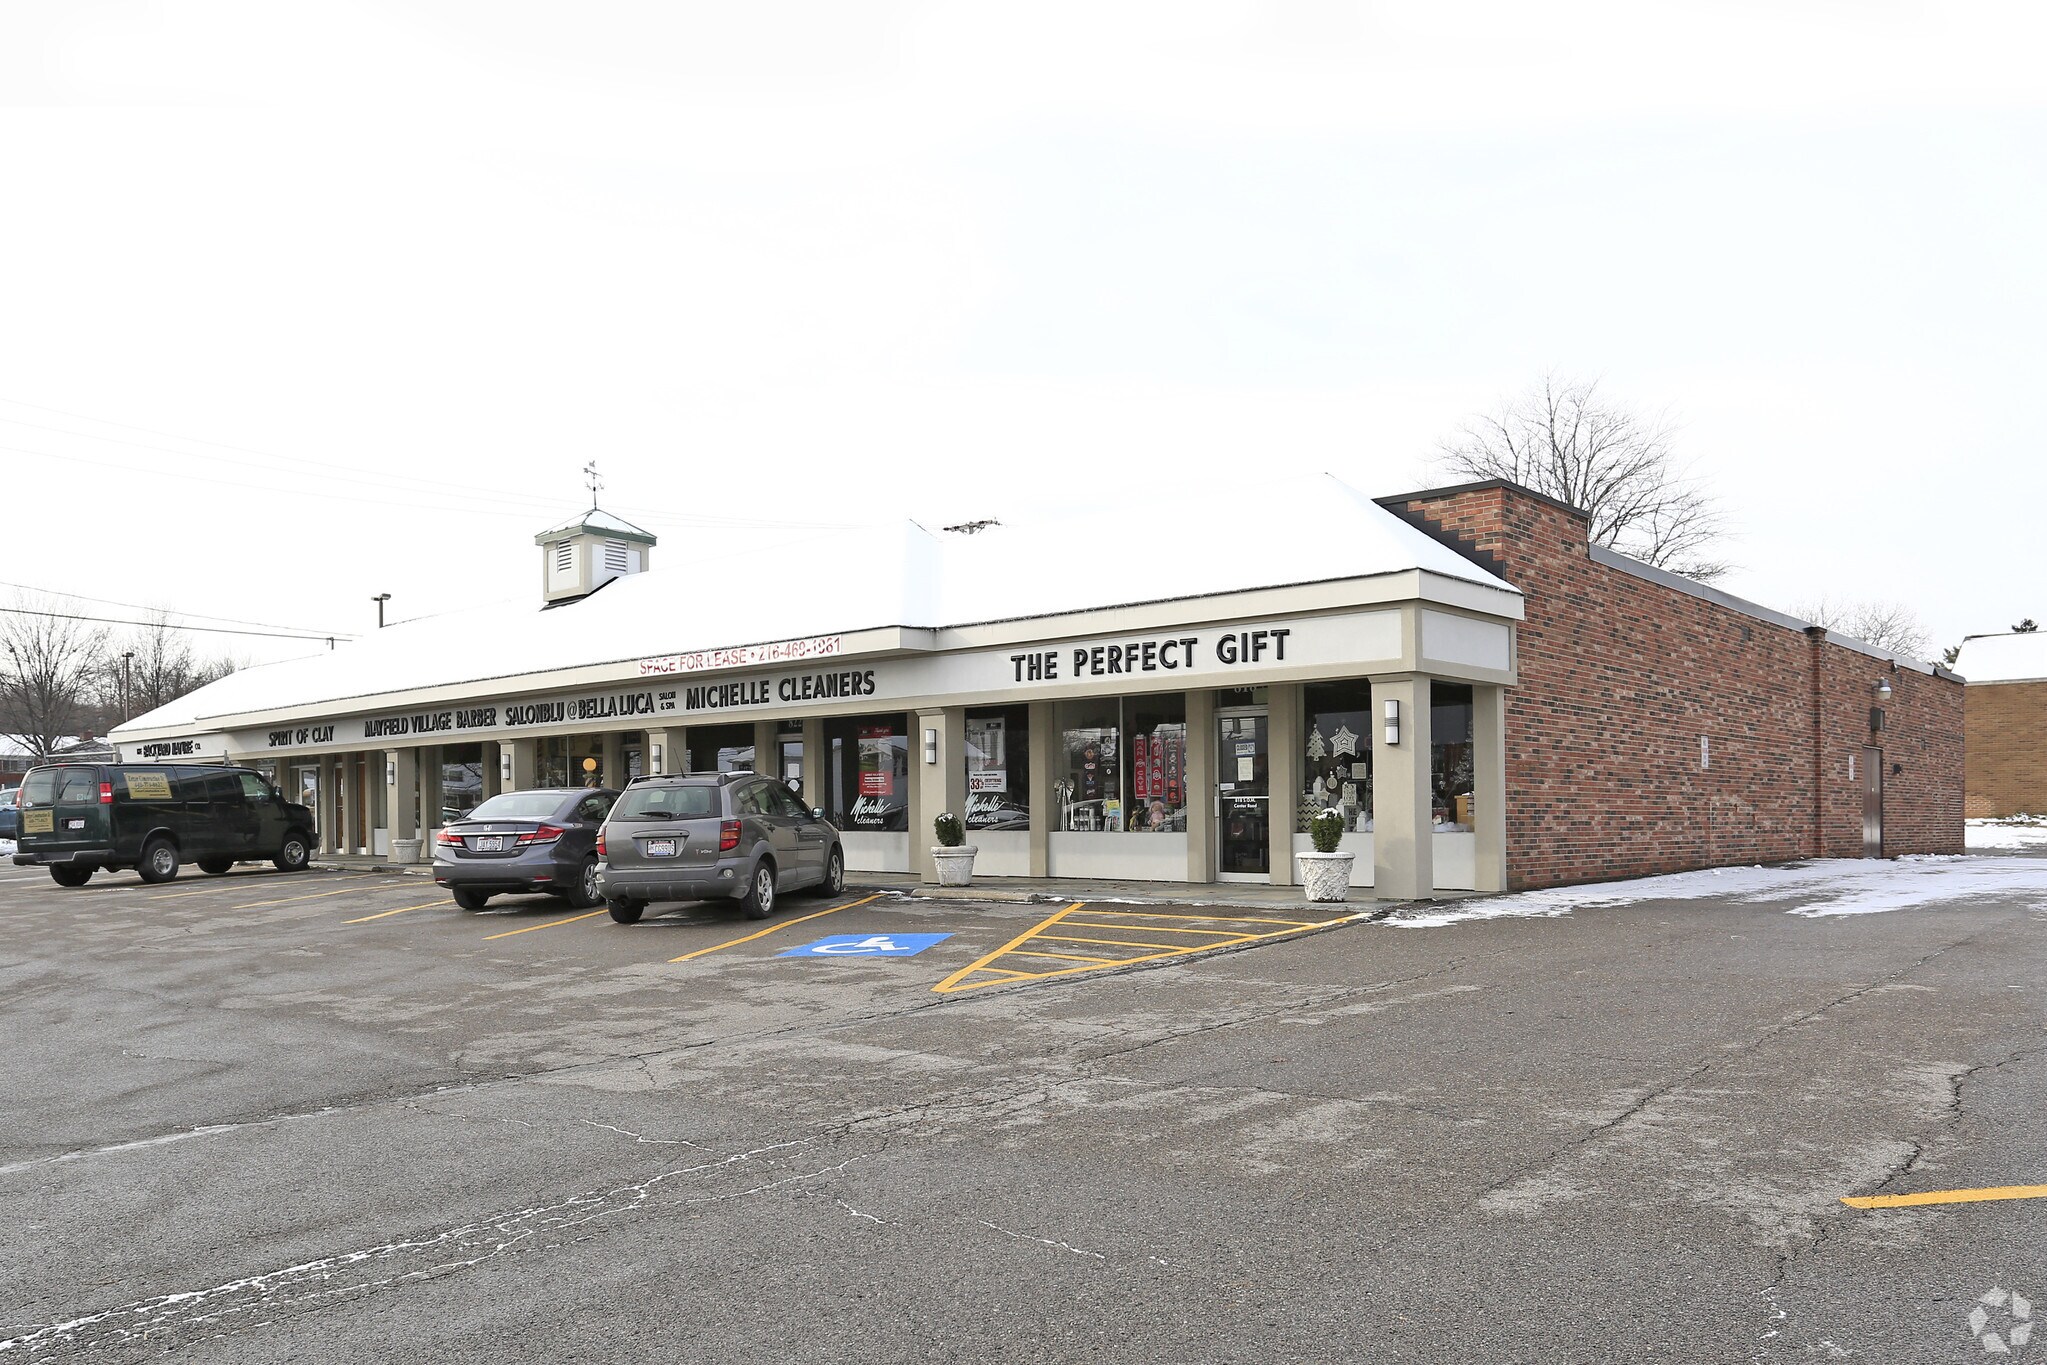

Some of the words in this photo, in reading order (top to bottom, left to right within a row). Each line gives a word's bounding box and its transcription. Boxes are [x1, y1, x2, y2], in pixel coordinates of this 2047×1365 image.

[640, 658, 676, 675] SPACE
[679, 655, 704, 671] FOR
[707, 648, 747, 667] LEASE
[1010, 651, 1058, 682] THE
[1073, 637, 1198, 677] PERFECT
[1216, 629, 1291, 665] GIFT
[658, 691, 676, 701] SALON
[686, 680, 770, 710] MICHELLE
[778, 670, 875, 701] CLEANERS
[619, 692, 656, 716] LUCA
[665, 702, 676, 710] SPA
[364, 717, 409, 738] MAYFIELD
[410, 711, 452, 733] VILLAGE
[456, 707, 497, 729] BARBER
[268, 729, 293, 747] SPIRIT
[296, 728, 309, 745] OF
[312, 725, 335, 743] CLAY
[850, 794, 892, 823] Michelle
[965, 792, 1006, 821] Michelle
[967, 813, 999, 823] cleaners
[856, 816, 885, 825] cleaners
